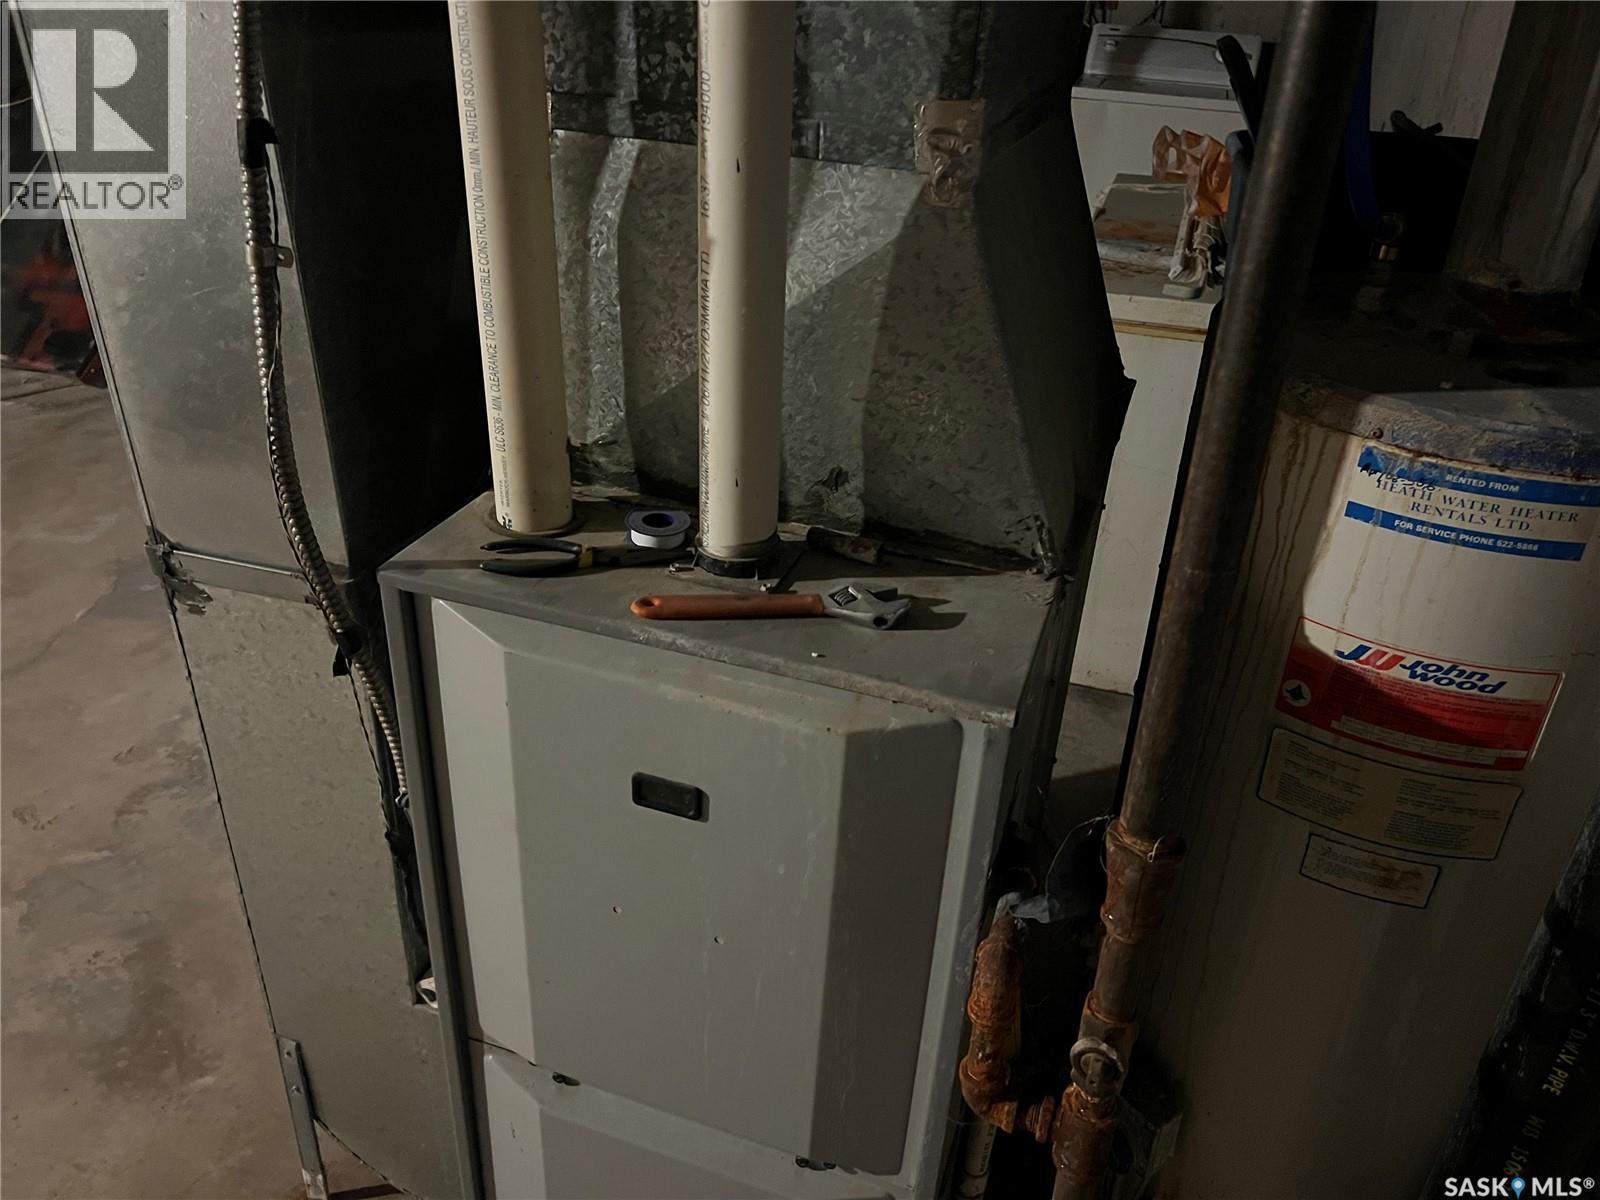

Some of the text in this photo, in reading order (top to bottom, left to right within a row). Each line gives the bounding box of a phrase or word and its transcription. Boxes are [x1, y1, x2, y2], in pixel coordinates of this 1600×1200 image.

[461, 68, 476, 97] SOUS
[700, 70, 711, 132] 194000
[464, 97, 479, 144] HAUTEUR
[473, 194, 490, 266] CONSTRUCTION
[480, 267, 496, 328] COMBUSTIBLE
[485, 328, 496, 342] TO
[485, 343, 501, 392] CLEARANCE
[492, 416, 505, 436] S636
[494, 436, 506, 453] ULC
[1445, 473, 1521, 493] RENTED FROM
[1375, 480, 1580, 524] HEATH WATER HEATER
[1410, 501, 1534, 532] RENTALS LTD.
[1394, 519, 1415, 531] FOR
[1415, 524, 1457, 540] SERVICE
[1458, 533, 1495, 547] PHONE
[1541, 1066, 1570, 1096] PIPE
